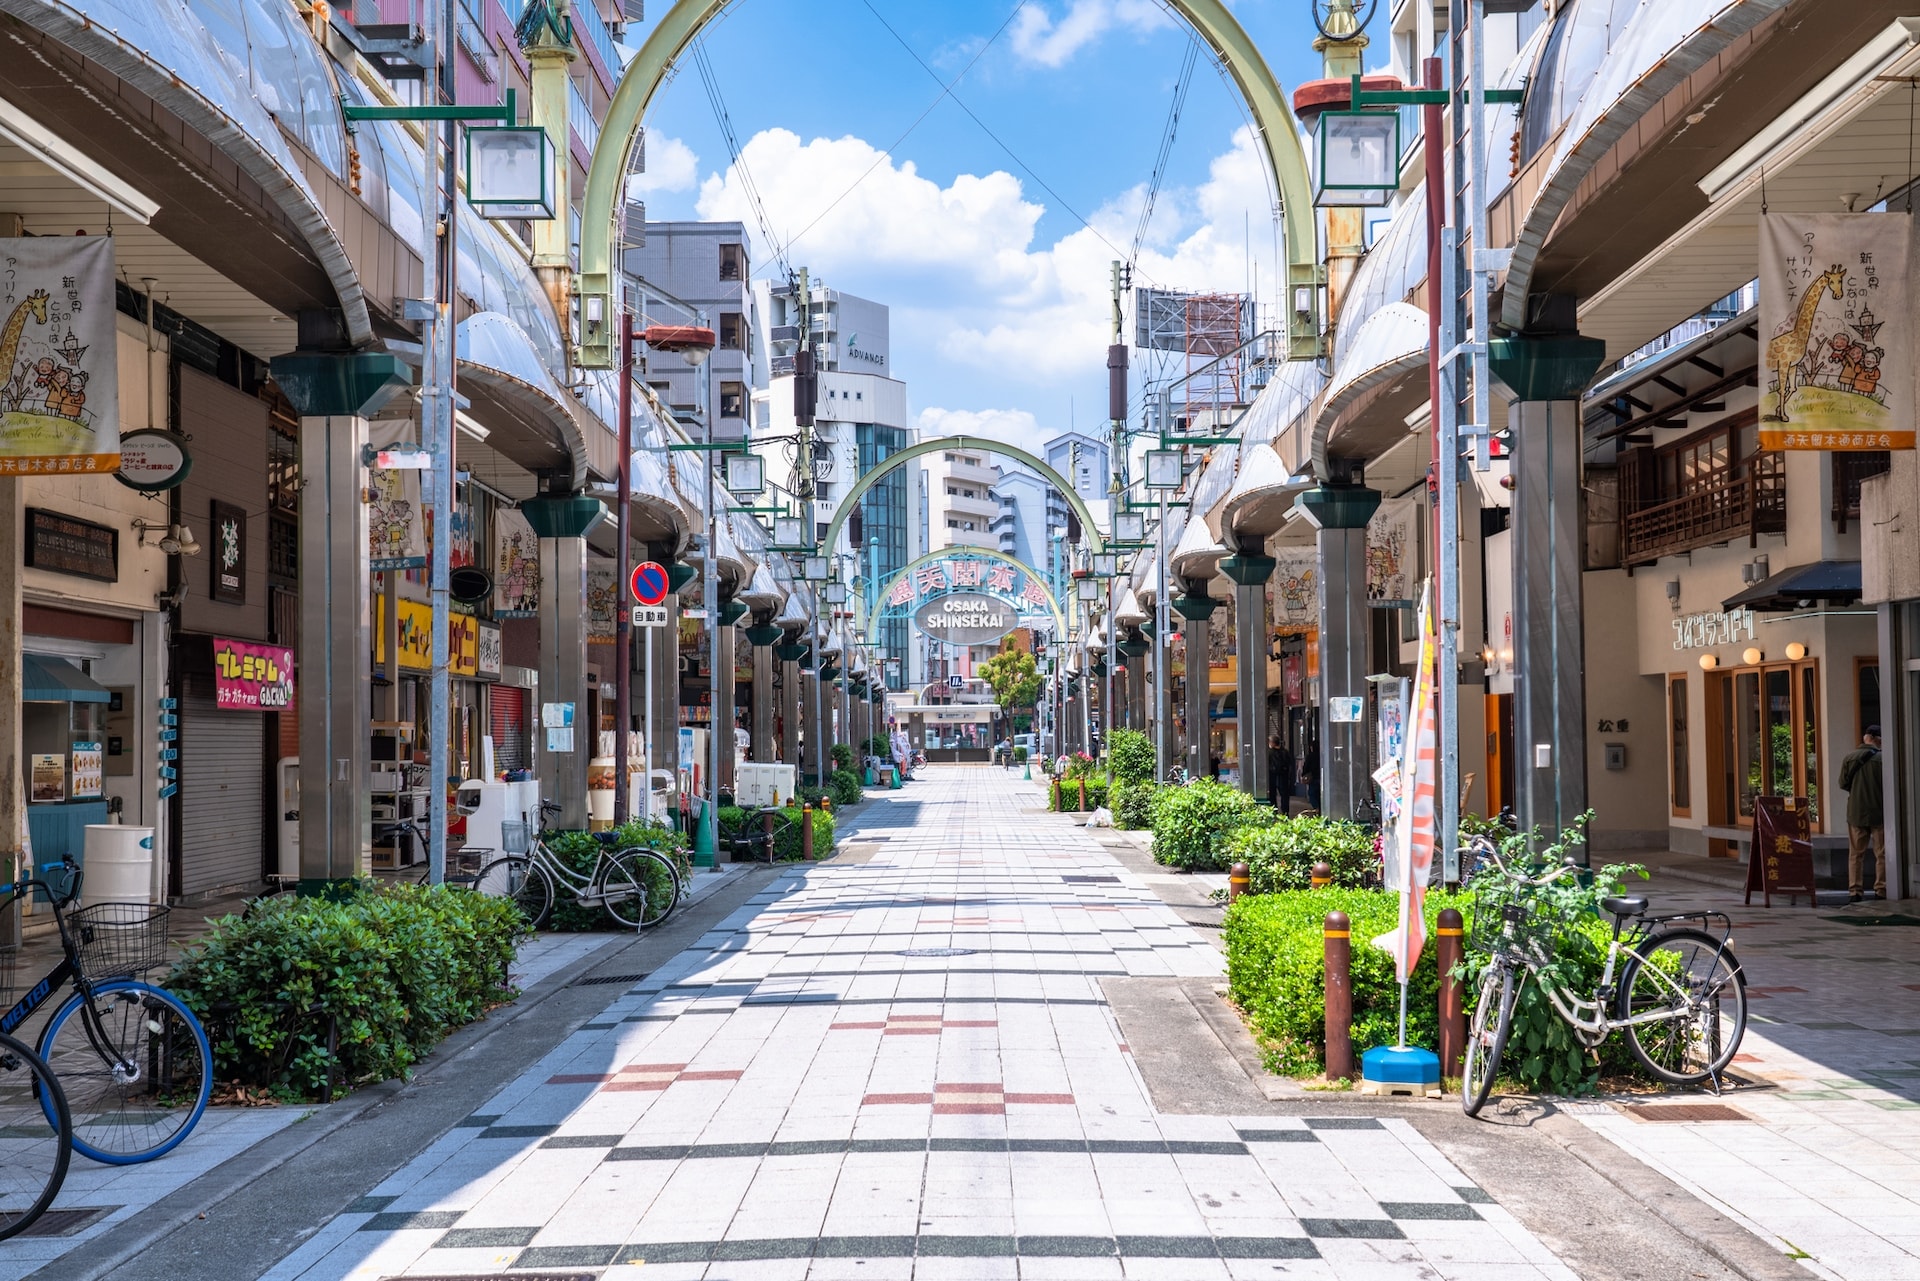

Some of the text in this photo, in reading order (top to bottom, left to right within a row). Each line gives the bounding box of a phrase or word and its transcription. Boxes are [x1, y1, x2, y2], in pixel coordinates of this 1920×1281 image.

[1801, 232, 1815, 278] アフリカ
[5, 257, 17, 304] アフリカ
[1786, 256, 1798, 302] サバンナ
[1844, 276, 1857, 320] となりは
[49, 300, 61, 344] となりは
[0, 457, 97, 472] 天閣本通商店会
[634, 611, 666, 622] 自動車
[927, 614, 1004, 628] SHINSEKAI
[943, 600, 989, 613] OSAKA
[216, 647, 278, 682] プレミアム
[1, 978, 50, 1033] MELTED
